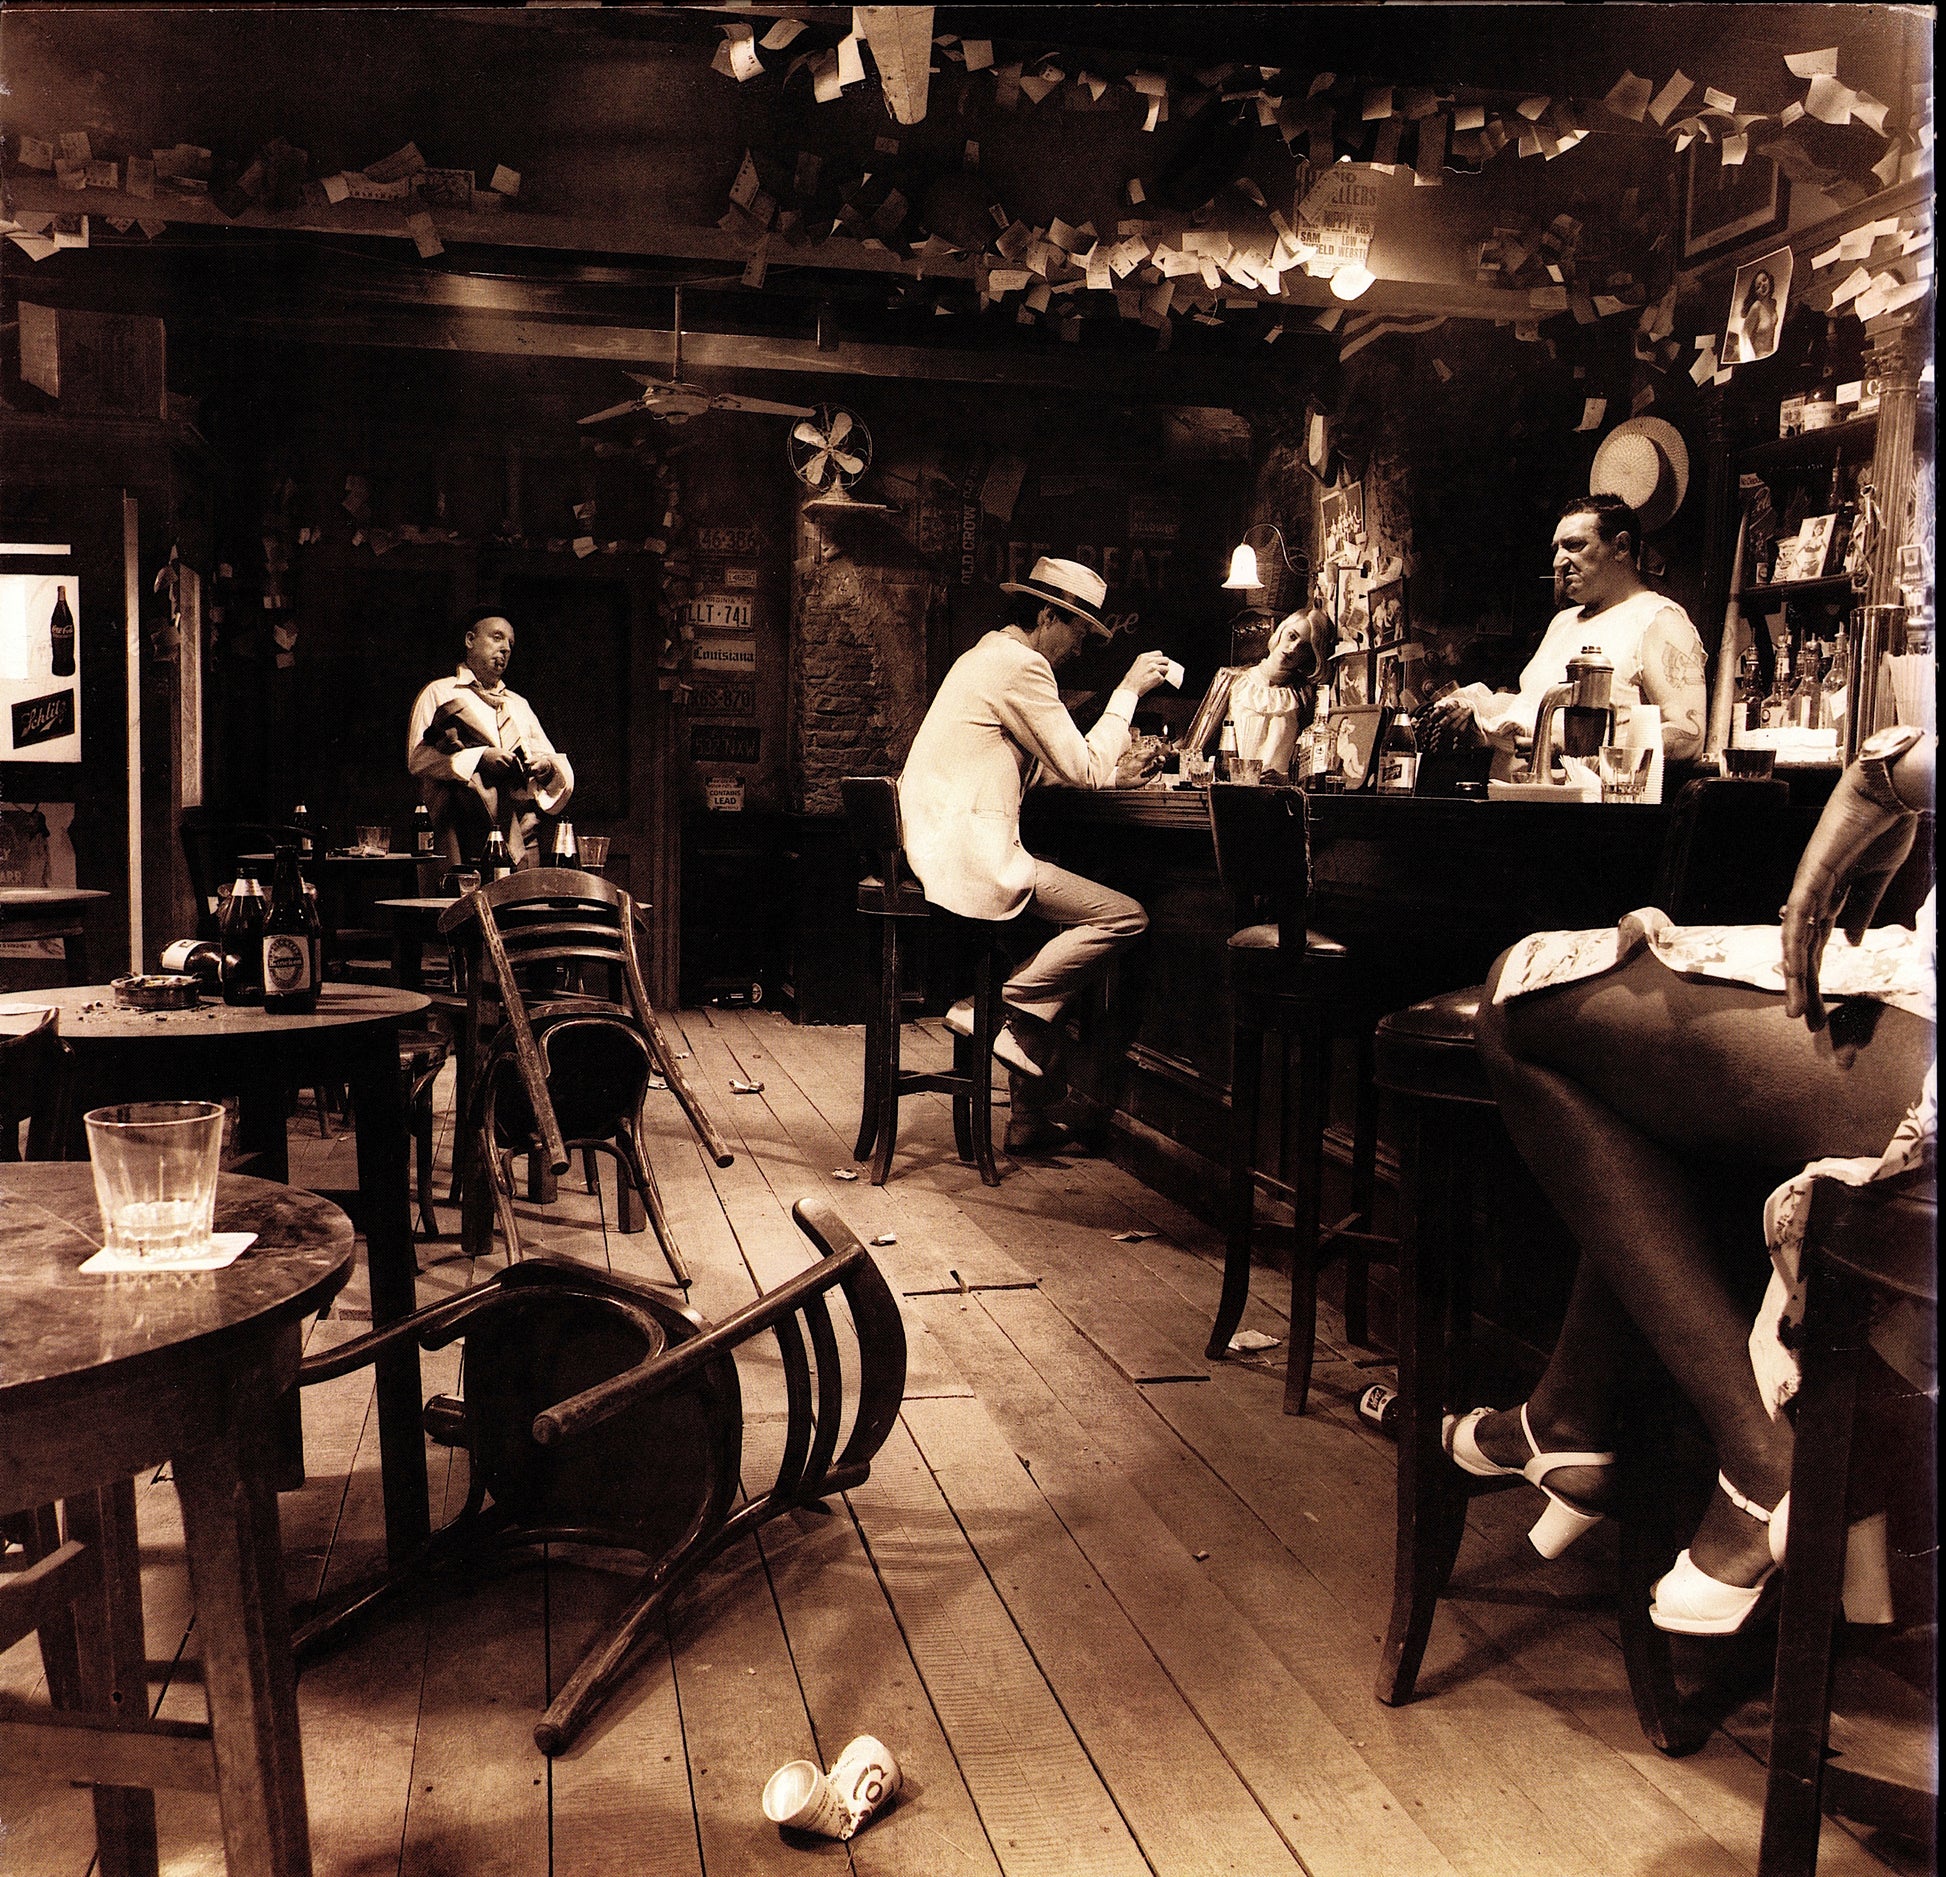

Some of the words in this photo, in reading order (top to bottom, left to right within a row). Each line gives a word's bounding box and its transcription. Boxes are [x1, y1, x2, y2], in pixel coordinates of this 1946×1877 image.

[1300, 231, 1321, 243] SAM
[962, 503, 977, 551] CROW
[961, 554, 975, 585] OLD
[694, 645, 754, 662] Louisiana
[20, 698, 68, 739] Schlitz
